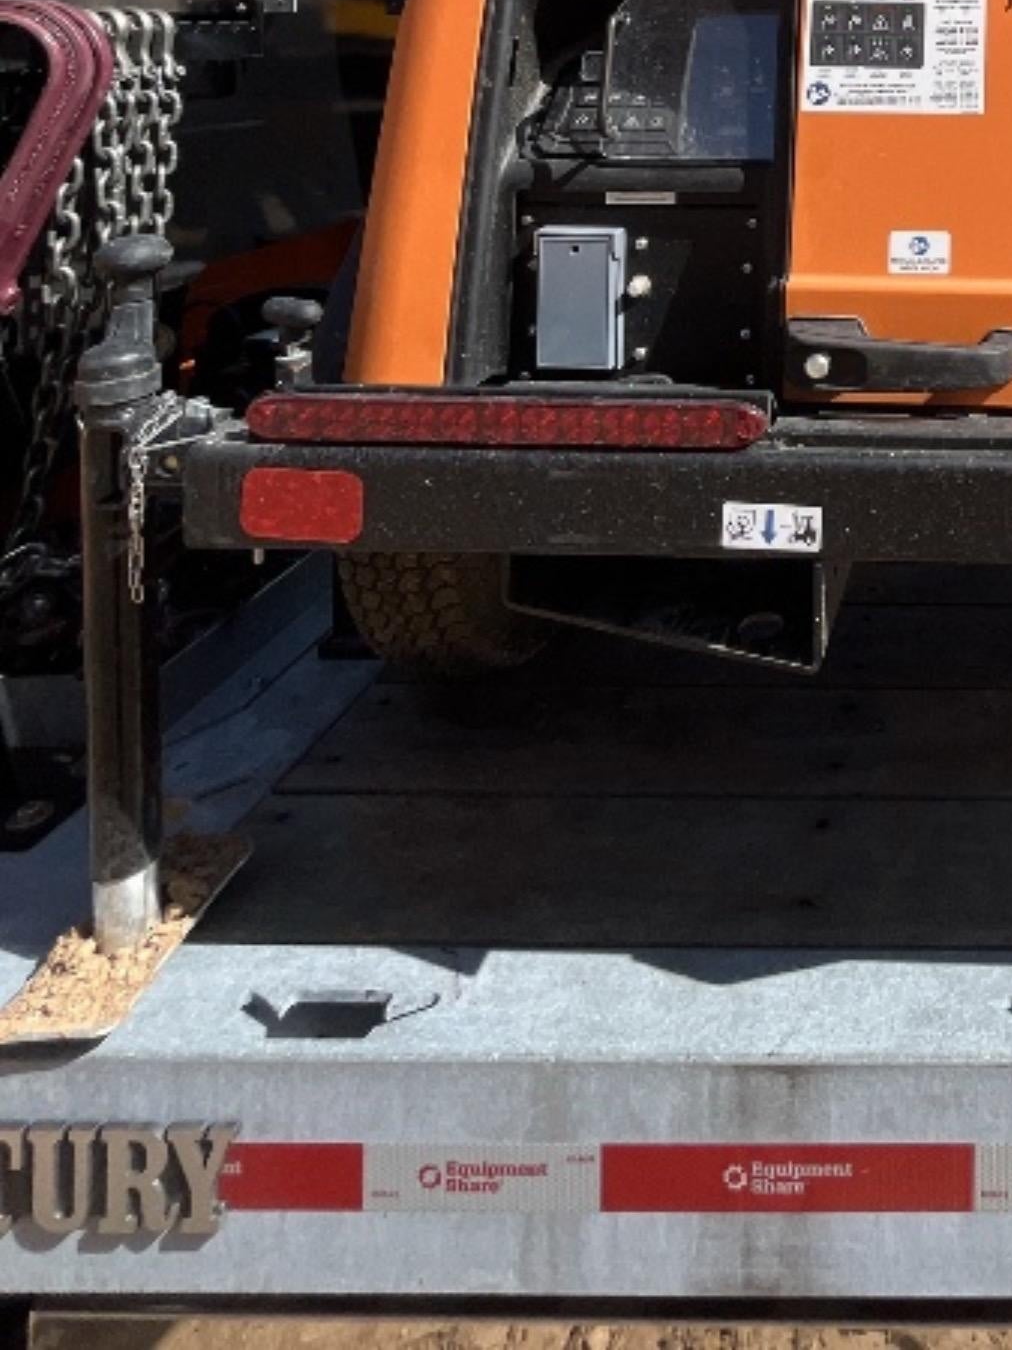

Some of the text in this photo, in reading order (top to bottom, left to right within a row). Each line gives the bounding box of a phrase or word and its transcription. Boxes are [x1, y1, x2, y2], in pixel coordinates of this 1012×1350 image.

[445, 1160, 549, 1178] Equipment
[751, 1161, 854, 1180] Equipment
[445, 1178, 501, 1194] Share
[751, 1179, 806, 1195] Share
